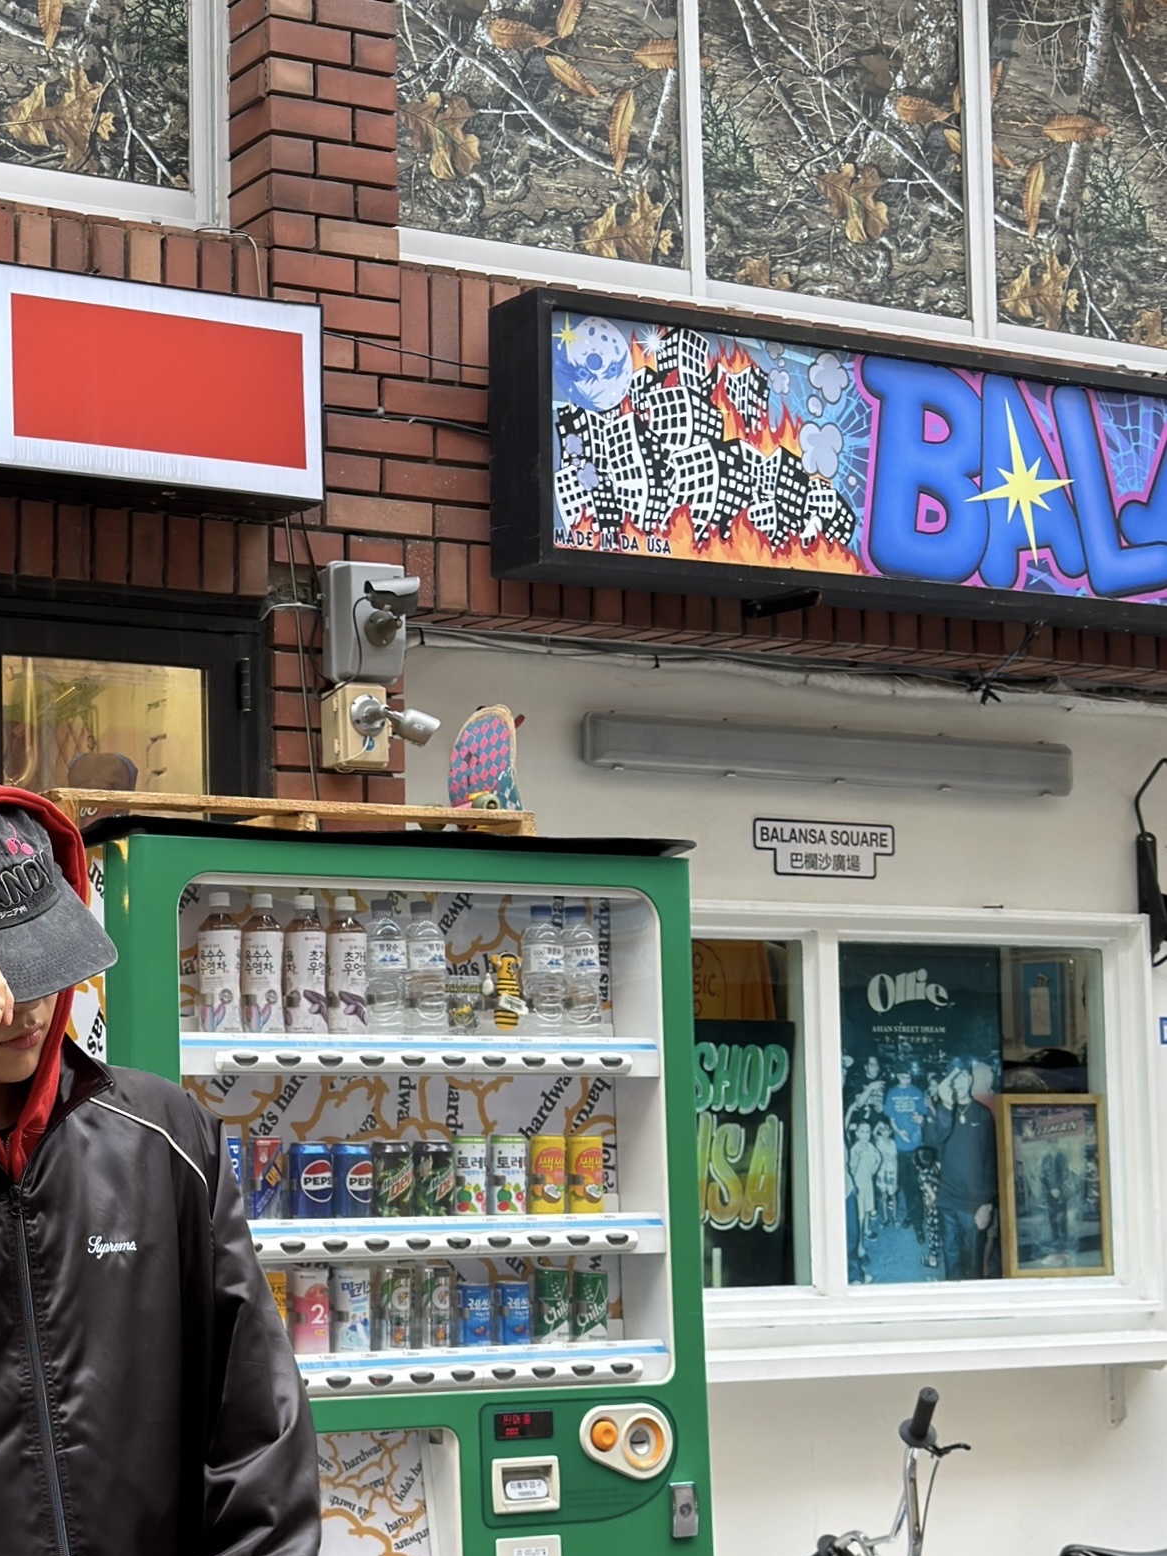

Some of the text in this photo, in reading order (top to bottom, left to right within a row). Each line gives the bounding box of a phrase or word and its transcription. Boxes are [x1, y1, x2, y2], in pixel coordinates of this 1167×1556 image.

[554, 529, 671, 554] MADE IN DA USA
[760, 826, 888, 848] BALANSA SQUARE
[244, 950, 272, 962] 옥수수
[245, 962, 273, 975] 수염차
[867, 968, 950, 1013] Ollie
[894, 1025, 919, 1033] STREET
[693, 1041, 789, 1114] SHOP
